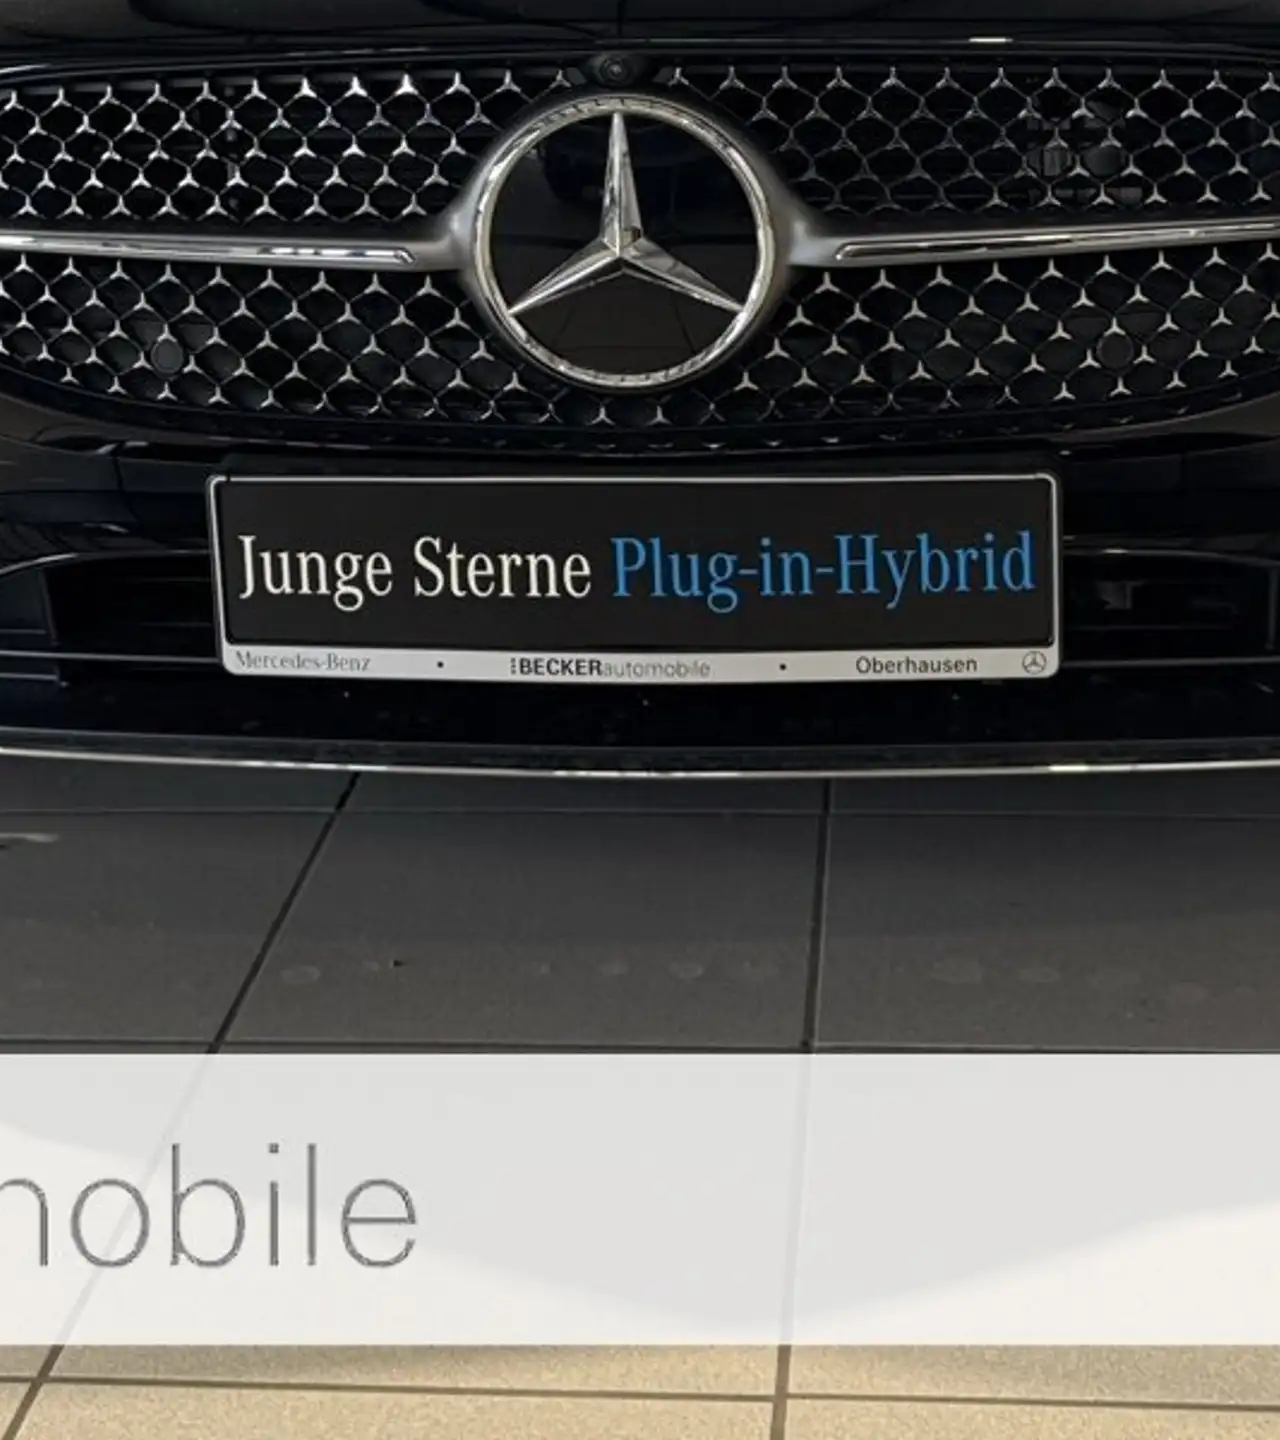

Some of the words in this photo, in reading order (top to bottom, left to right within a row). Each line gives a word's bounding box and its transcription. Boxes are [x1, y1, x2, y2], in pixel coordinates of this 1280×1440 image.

[237, 534, 393, 612] Junge
[413, 535, 592, 599] Sterne
[610, 530, 1037, 614] Plug-in-Hybrid
[235, 649, 372, 673] Mercedes-Benz
[855, 655, 979, 676] Oberhausen
